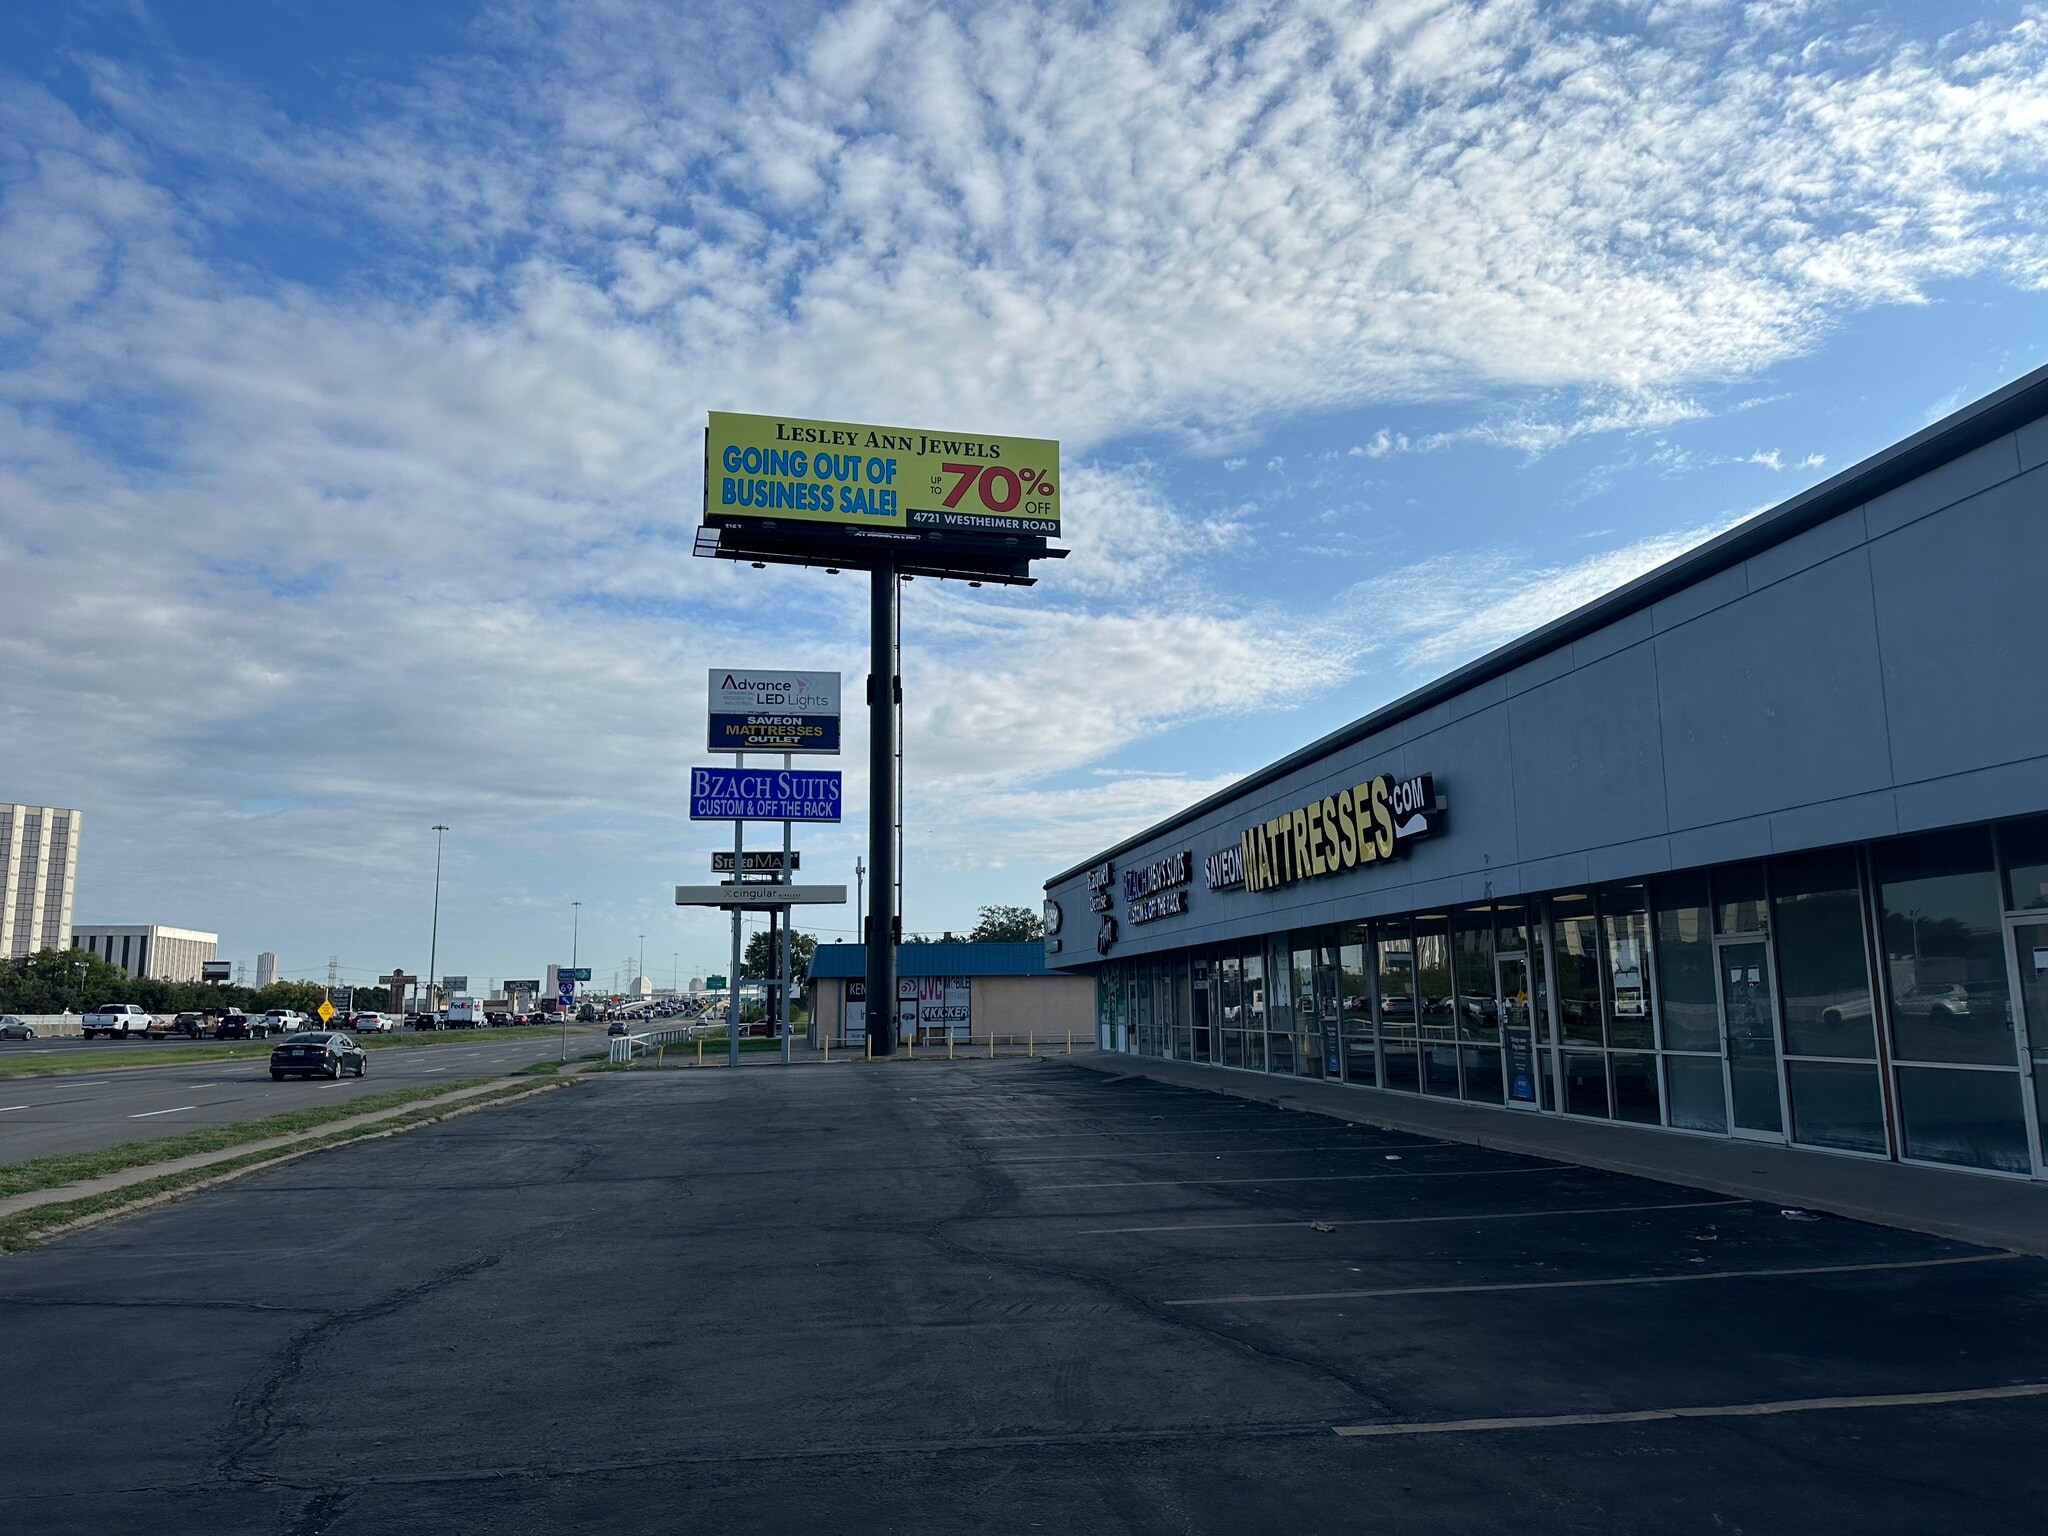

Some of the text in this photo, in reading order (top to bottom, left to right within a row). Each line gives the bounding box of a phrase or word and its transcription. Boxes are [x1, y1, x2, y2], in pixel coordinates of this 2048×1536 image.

[776, 423, 1001, 459] LESLEY ANN JEWELS
[722, 445, 897, 485] GOING OUT OF
[930, 475, 942, 485] UP
[941, 463, 1055, 512] 70%
[722, 477, 897, 517] BUSINESS SALE!
[930, 485, 942, 495] TO
[1025, 501, 1051, 515] OFF
[913, 512, 1056, 532] 4721 WESTHEIMER ROAD
[721, 674, 792, 691] Advance
[757, 693, 829, 709] LED Lights
[747, 716, 802, 726] SAVEON
[726, 725, 823, 737] MATTRESSES
[748, 736, 801, 744] OUTLET
[693, 770, 839, 801] BZACH SUITS
[698, 799, 833, 817] CUSTOM & OFF THE RACK
[1204, 847, 1244, 890] SAVEON
[1241, 775, 1394, 893] MATTRESSES
[714, 854, 753, 869] STEEO
[1166, 851, 1185, 887] SUITS
[733, 888, 777, 900] cingular
[560, 983, 573, 993] 69
[920, 976, 942, 1000] JVC
[450, 1002, 473, 1010] FedEx
[930, 1007, 969, 1018] KICKER
